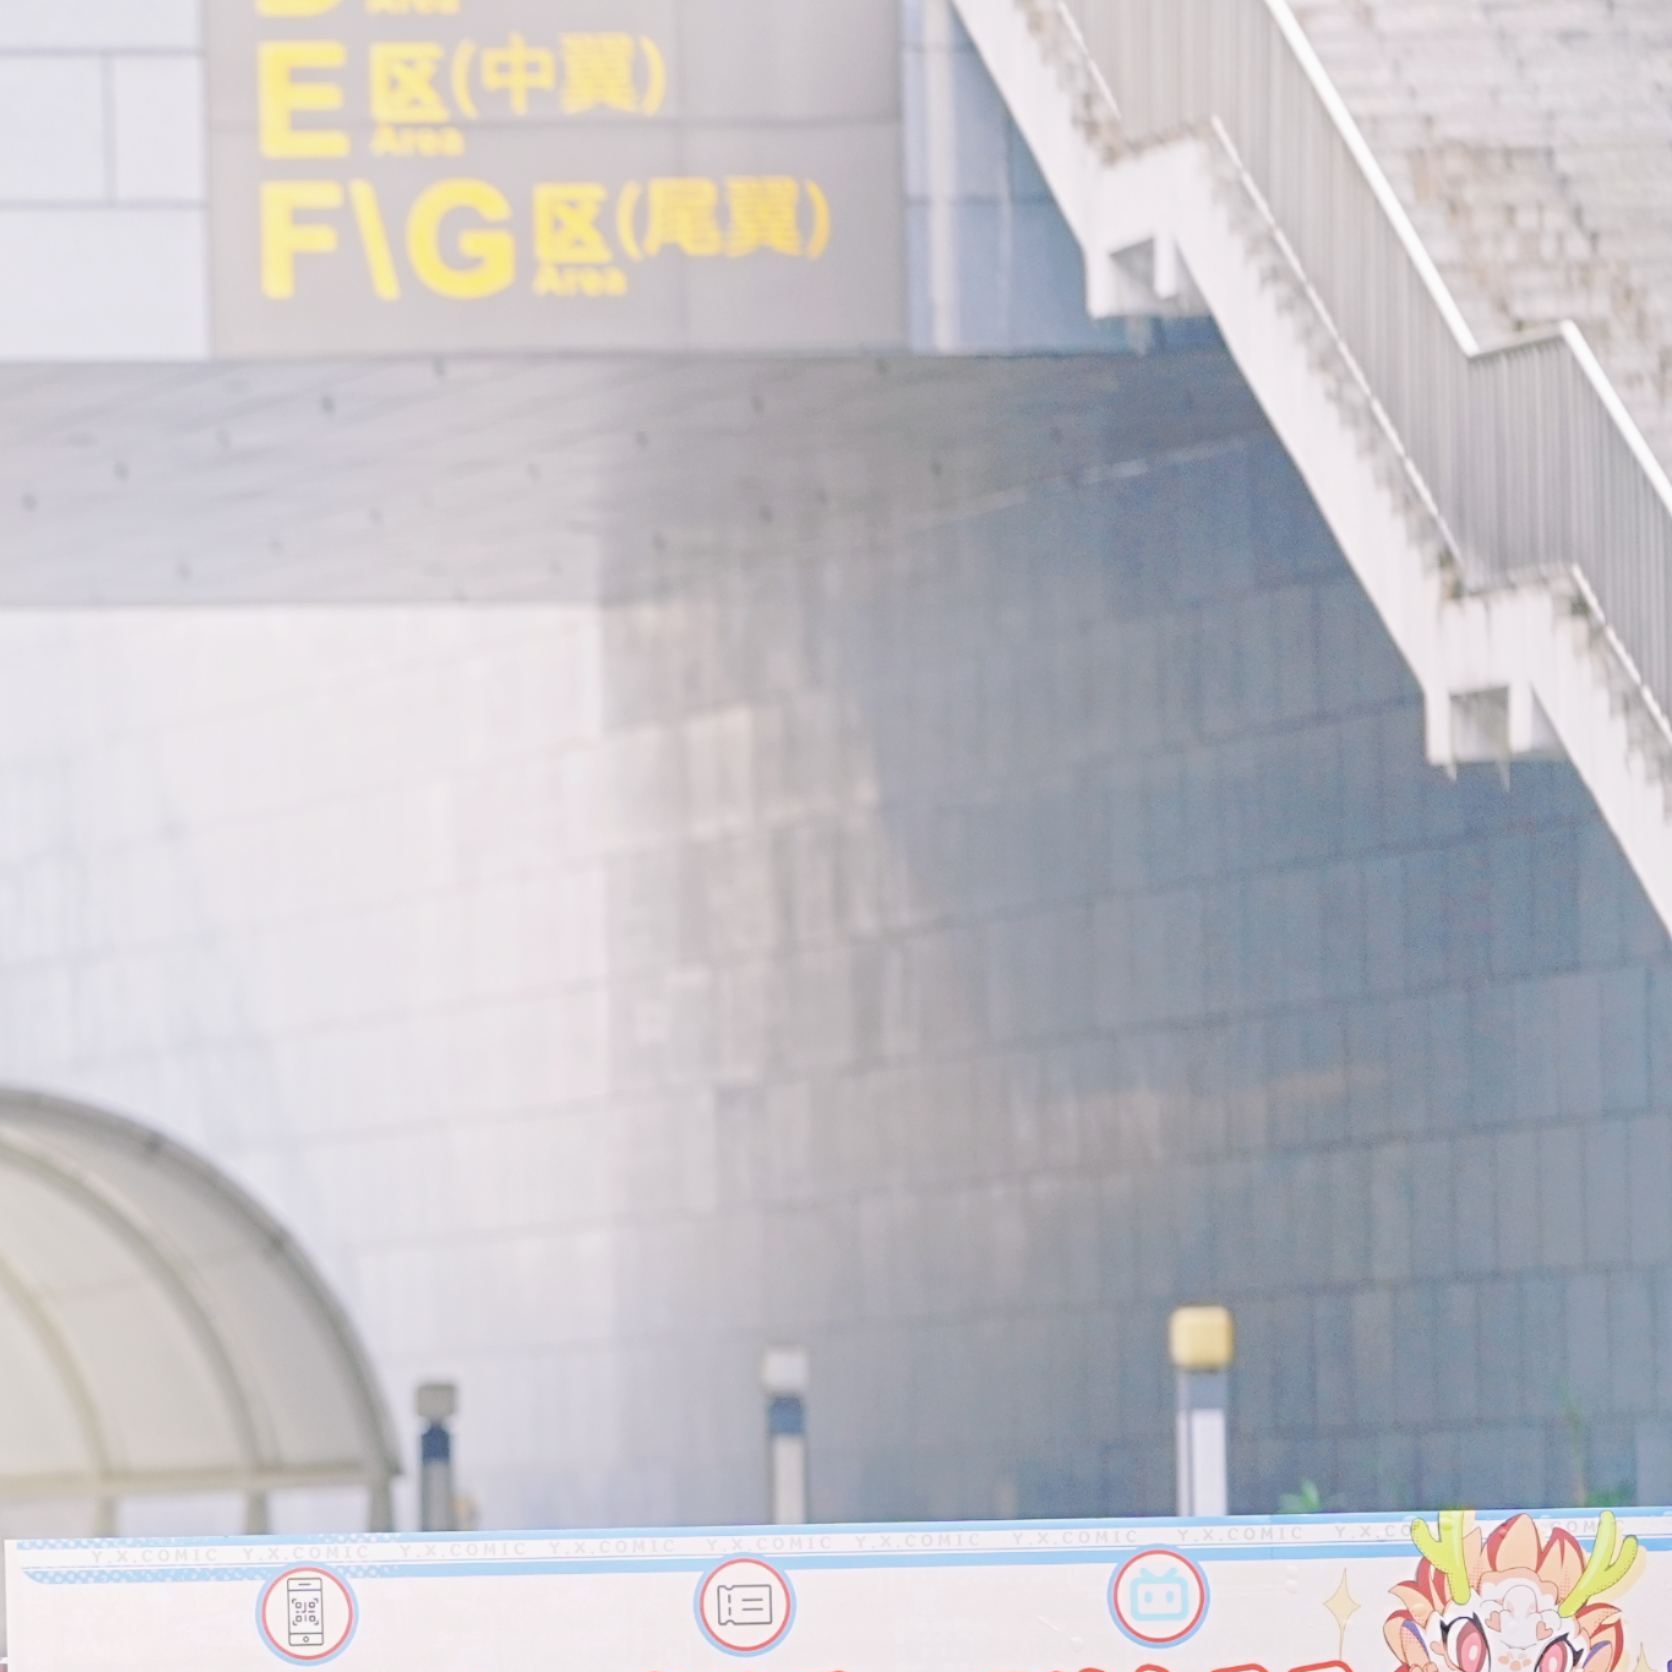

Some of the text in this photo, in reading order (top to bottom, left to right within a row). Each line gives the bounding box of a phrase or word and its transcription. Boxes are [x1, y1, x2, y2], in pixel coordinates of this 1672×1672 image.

[258, 40, 350, 158] E
[371, 126, 463, 156] Area
[260, 178, 516, 300] F\G
[533, 265, 627, 296] Area
